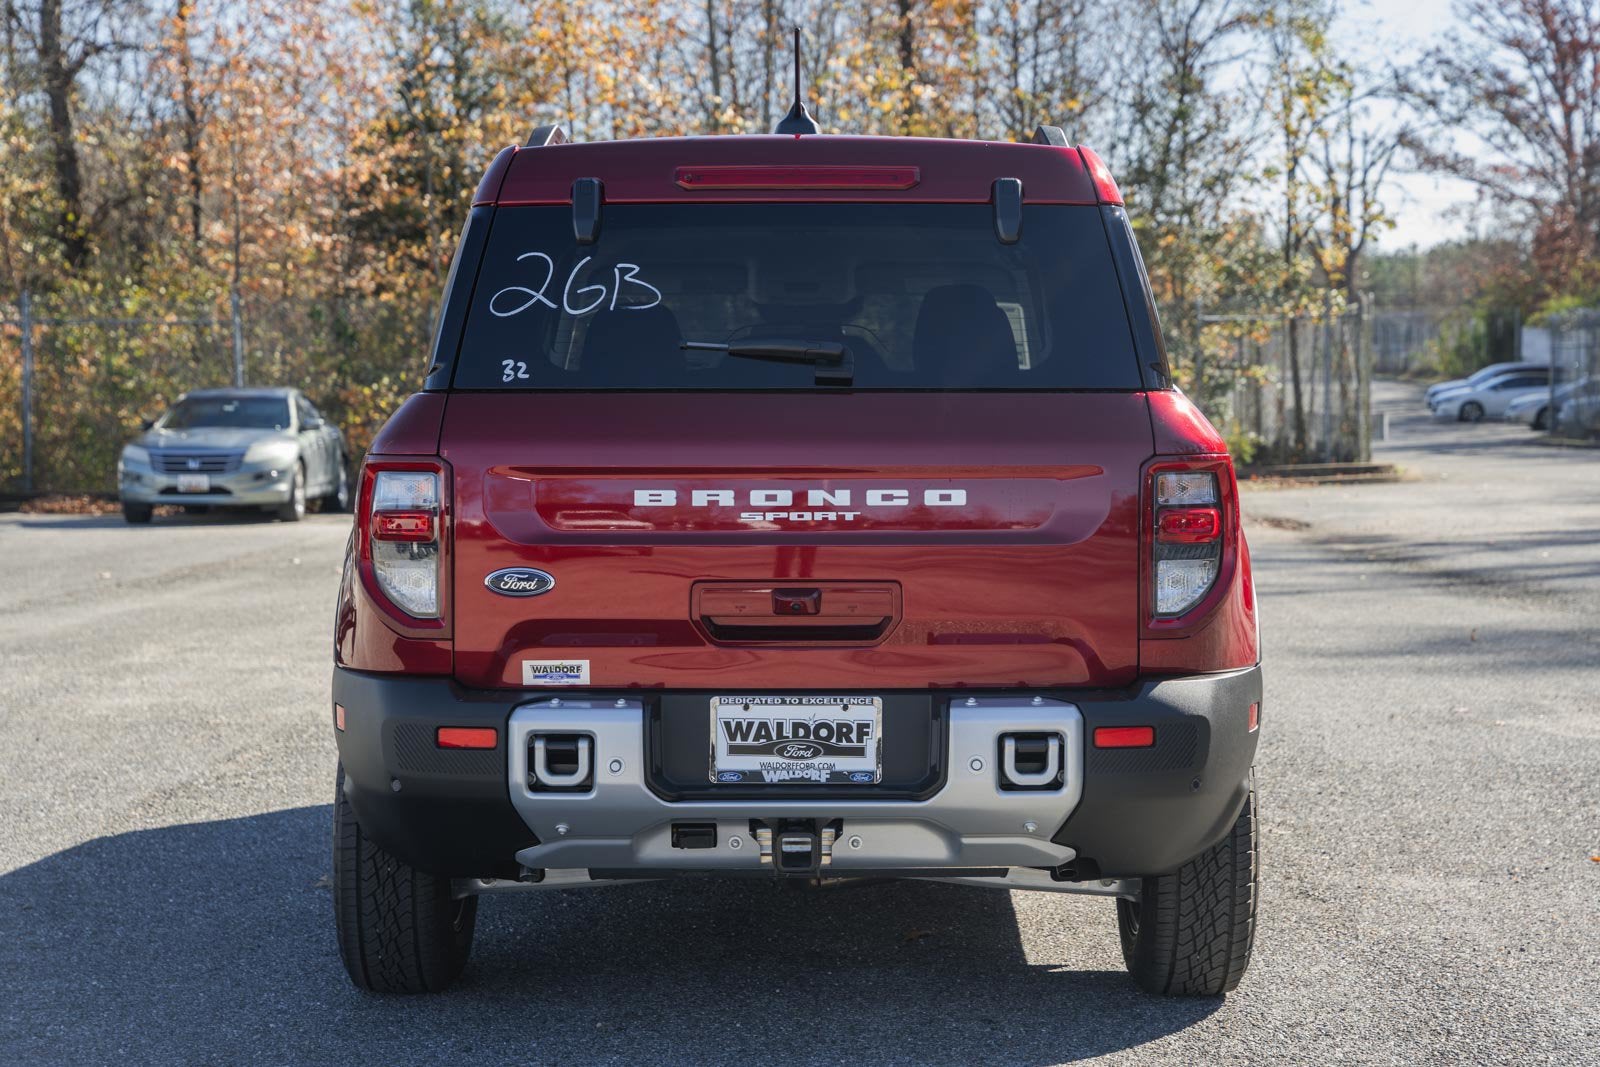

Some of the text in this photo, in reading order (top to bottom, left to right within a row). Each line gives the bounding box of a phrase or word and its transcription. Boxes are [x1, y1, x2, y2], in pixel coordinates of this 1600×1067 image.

[501, 358, 530, 383] 32
[633, 489, 967, 507] BRONCO
[740, 511, 861, 521] SPORT
[500, 573, 538, 590] Ford
[531, 664, 582, 674] WALDORF
[721, 697, 873, 705] DEDICATED TO EXCELLENCE
[720, 718, 873, 744] WALDORF
[784, 744, 814, 758] Ford
[759, 761, 836, 770] WALDORFFORD.COM
[761, 768, 831, 783] WALDORF
